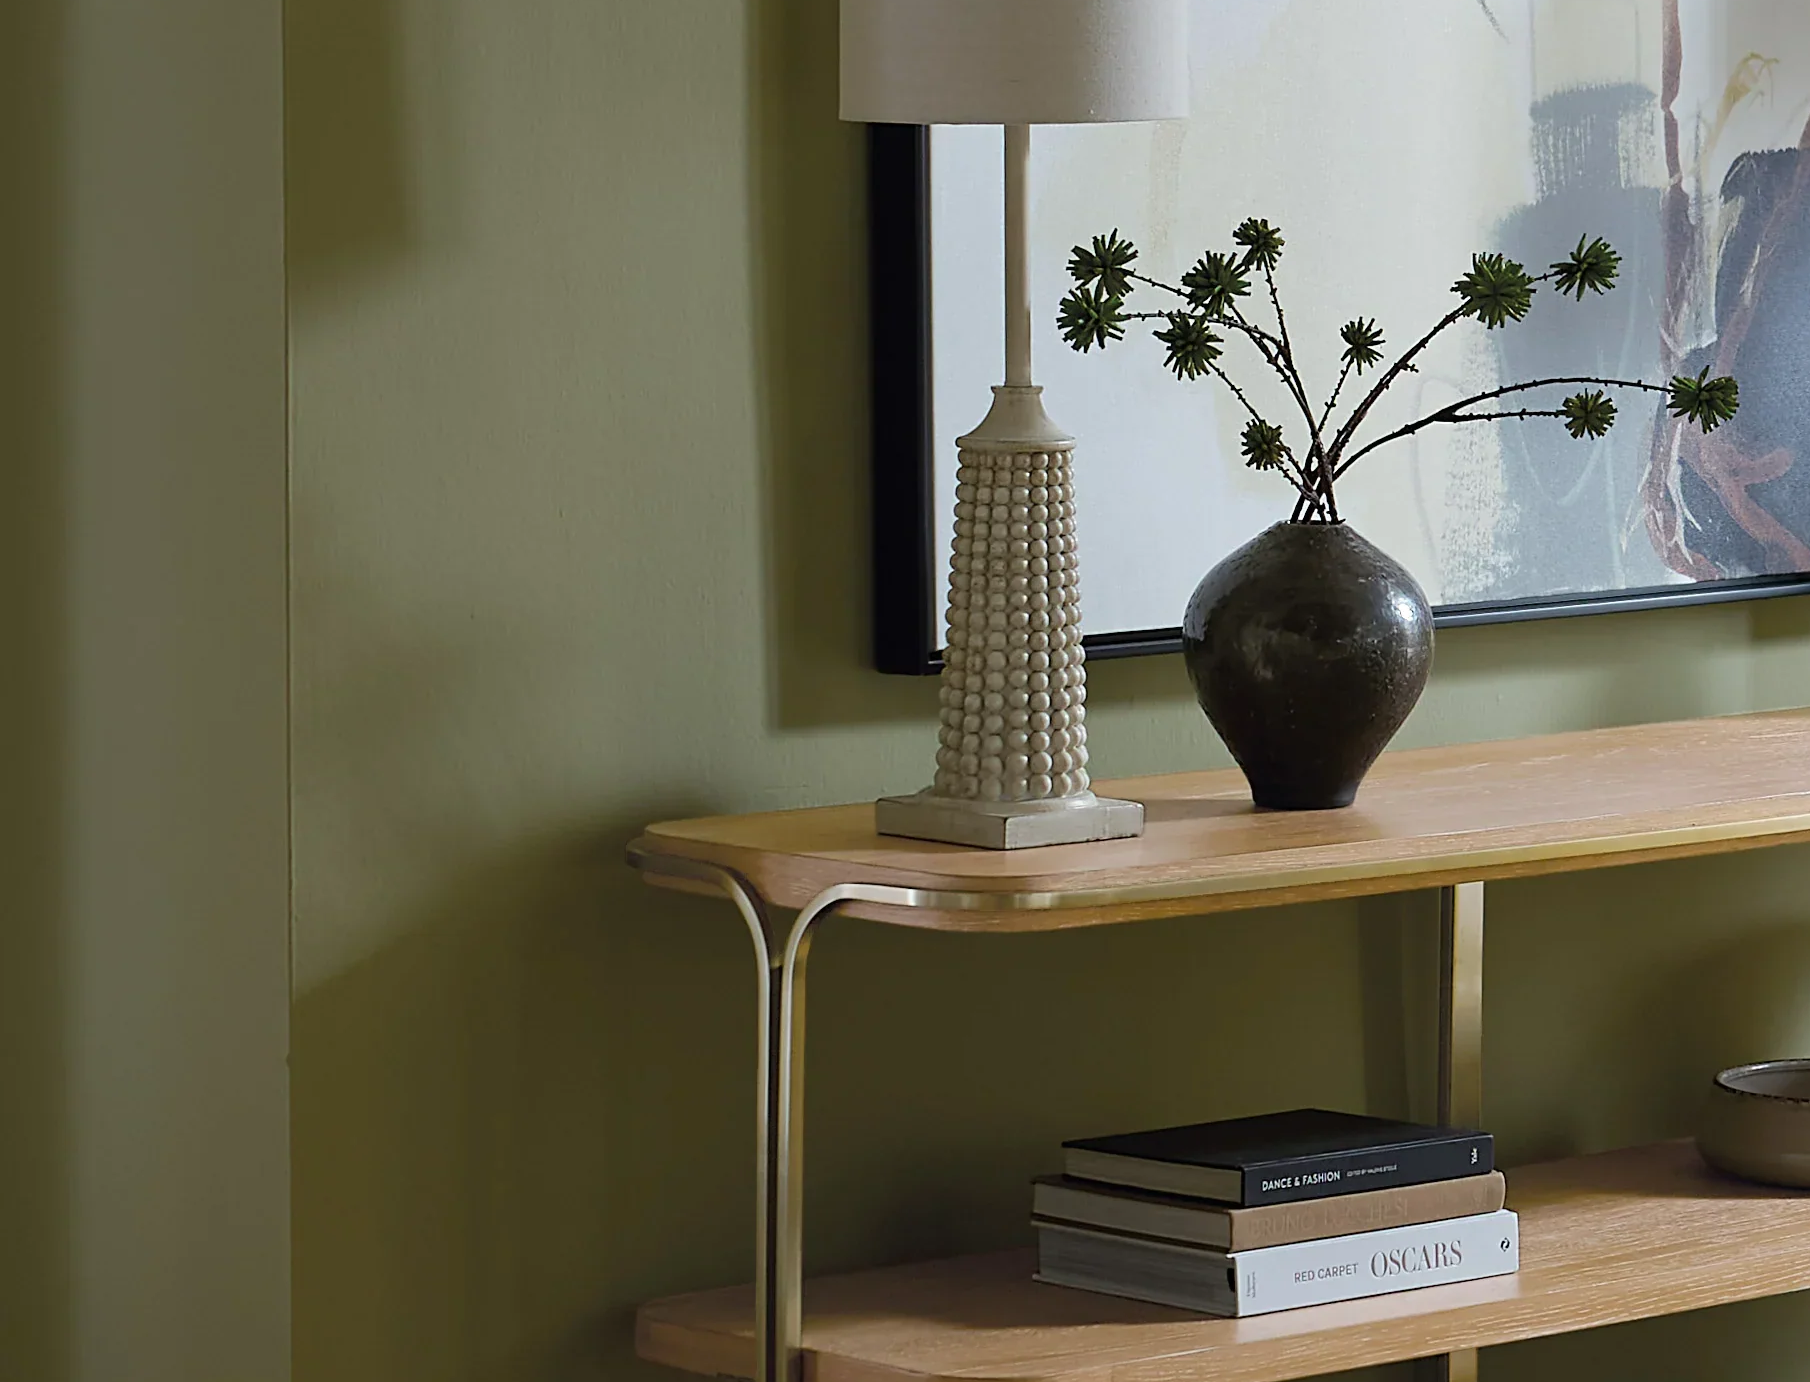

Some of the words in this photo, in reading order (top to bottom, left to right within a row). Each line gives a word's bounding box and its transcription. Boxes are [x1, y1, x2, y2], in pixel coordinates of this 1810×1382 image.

[1262, 1177, 1292, 1191] DANCE
[1294, 1176, 1301, 1187] &
[1302, 1170, 1341, 1186] FASHION
[1294, 1271, 1315, 1283] RED
[1317, 1263, 1359, 1280] CARPET
[1371, 1240, 1462, 1278] OSCARS
